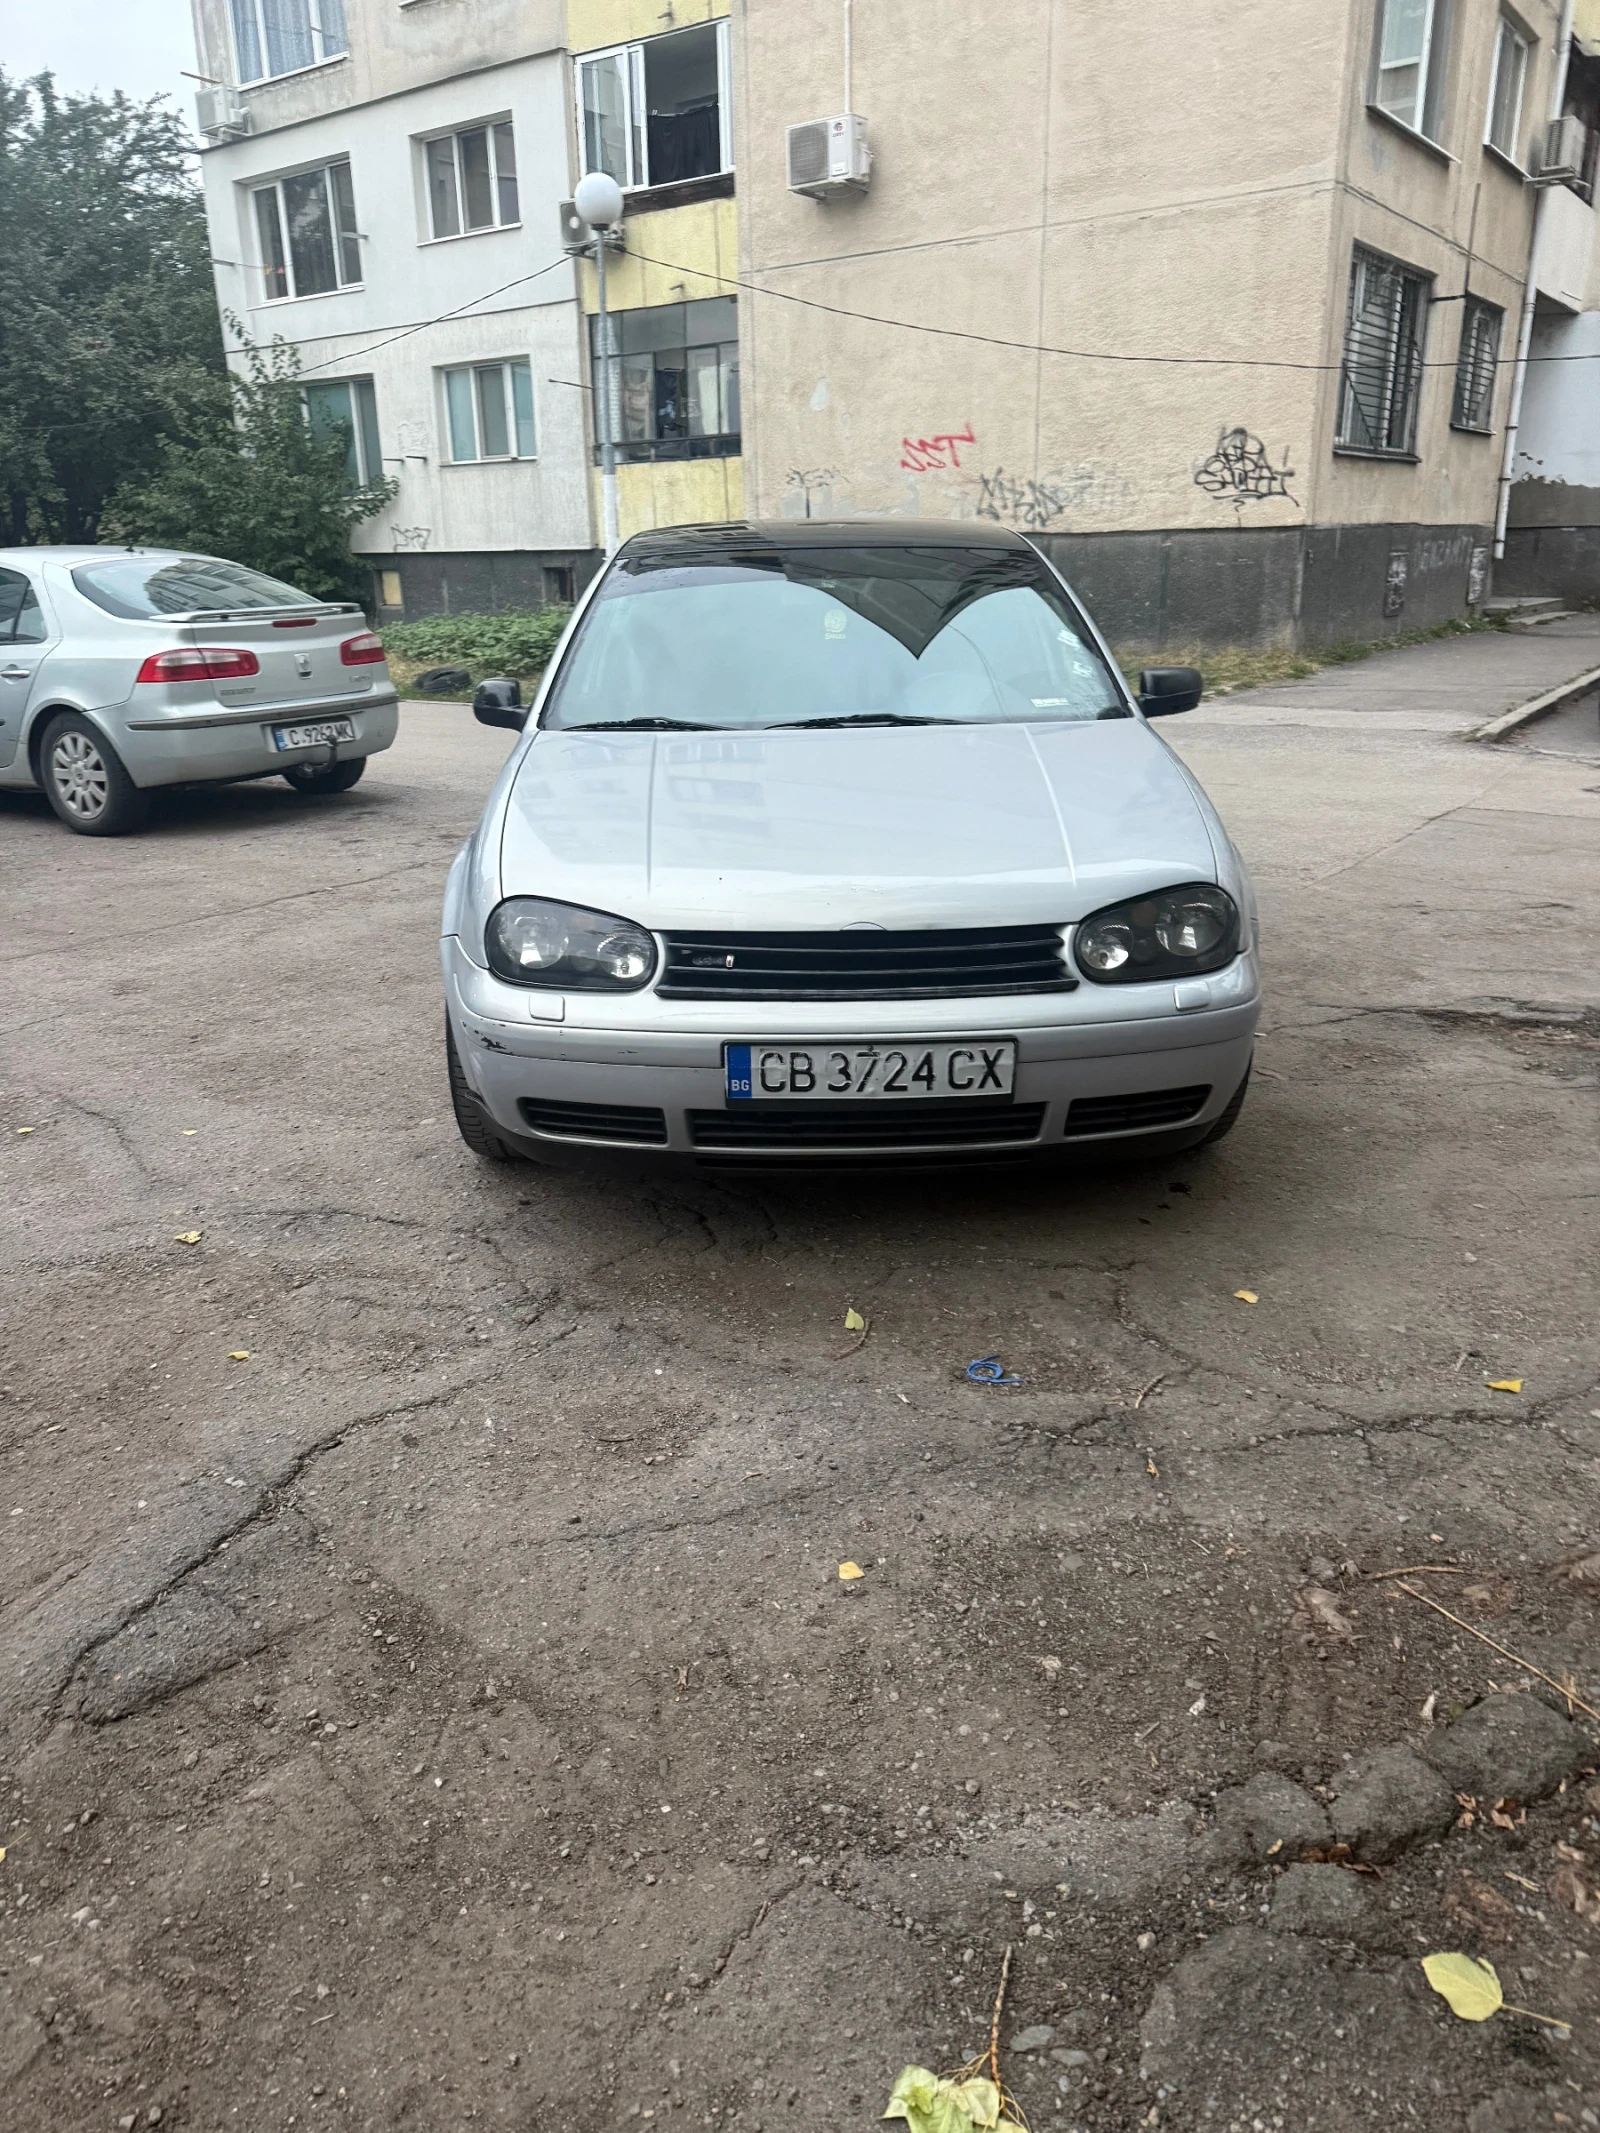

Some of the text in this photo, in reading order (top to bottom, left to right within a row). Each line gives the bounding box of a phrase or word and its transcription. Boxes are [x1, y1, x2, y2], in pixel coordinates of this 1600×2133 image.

[759, 1048, 1005, 1093] CB 3724 CX
[731, 1079, 750, 1092] BG
